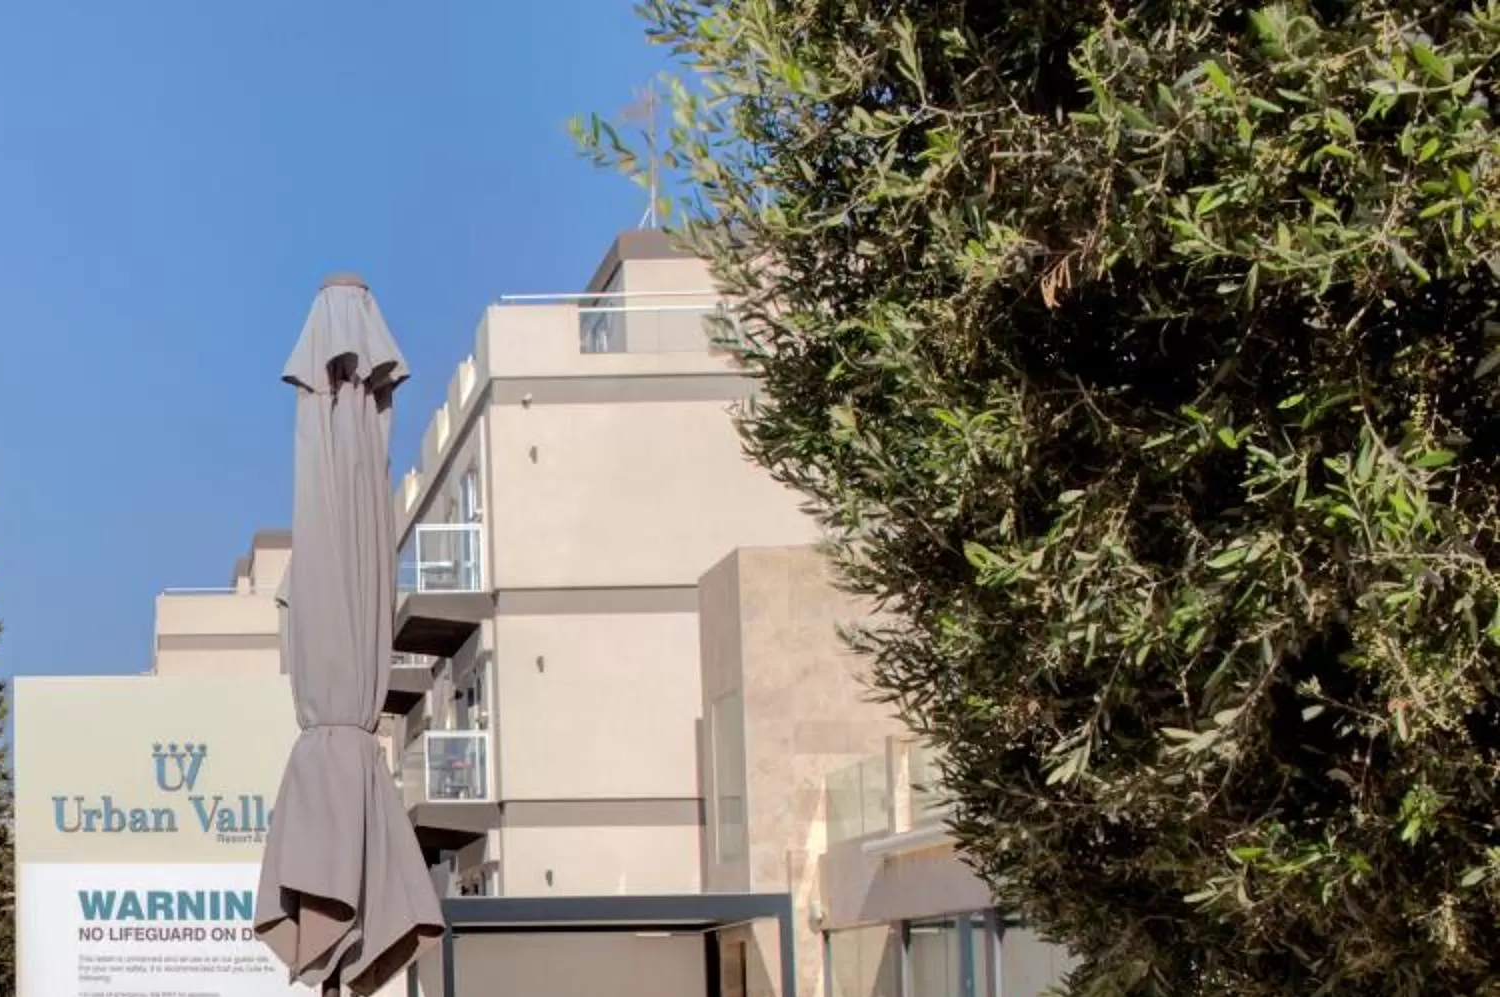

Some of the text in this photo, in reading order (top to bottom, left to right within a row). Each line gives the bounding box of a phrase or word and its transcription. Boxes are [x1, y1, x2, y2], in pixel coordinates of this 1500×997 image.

[51, 795, 275, 833] Urban Vall
[77, 890, 254, 921] WARNIN
[78, 927, 104, 942] NO
[108, 927, 207, 942] LIFEGUARD
[210, 927, 237, 942] ON
